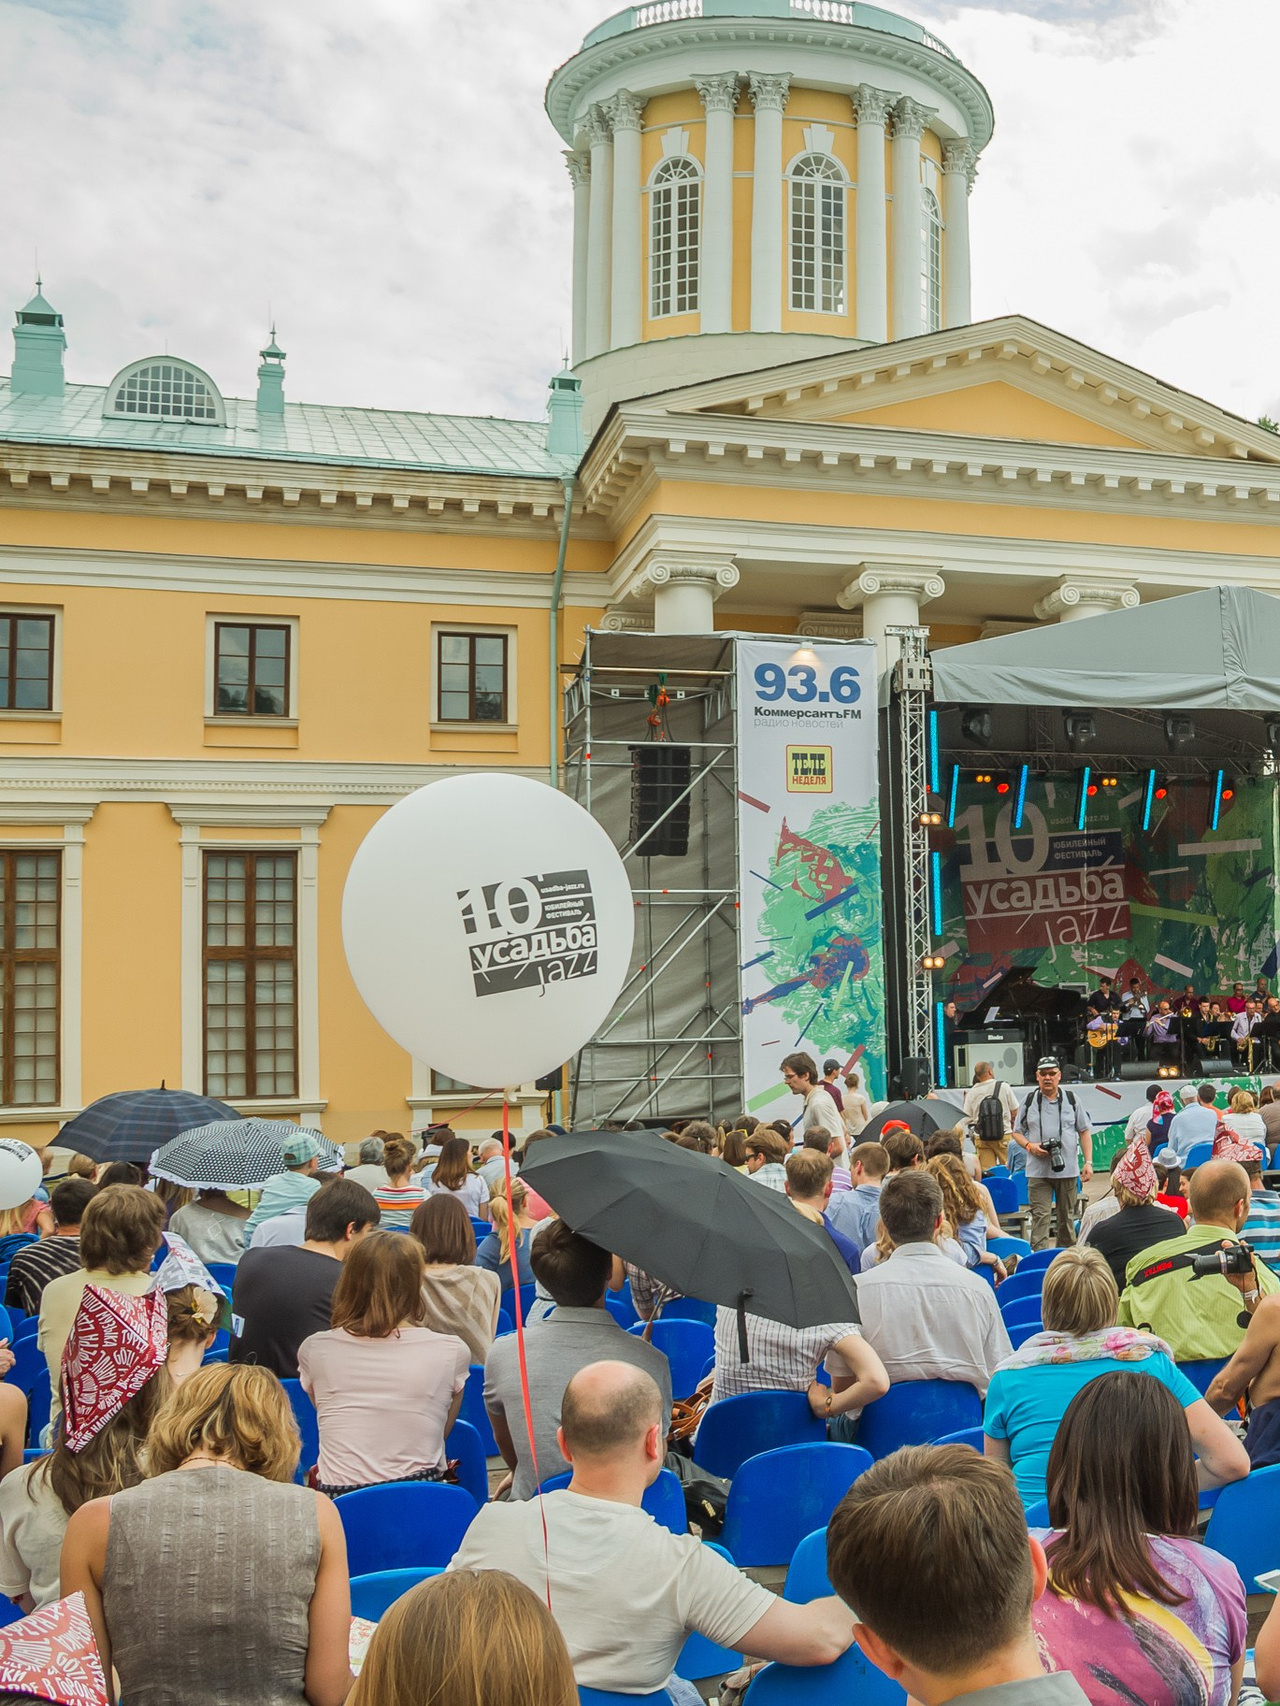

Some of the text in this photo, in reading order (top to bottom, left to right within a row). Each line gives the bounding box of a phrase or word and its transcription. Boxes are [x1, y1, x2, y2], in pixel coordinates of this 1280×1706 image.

[754, 662, 861, 704] 93.6
[754, 718, 844, 729] радио новостей
[792, 753, 826, 775] ТЕЛЕ
[792, 776, 827, 786] НЕДЕЛЯ
[955, 801, 1050, 881] 10
[1053, 837, 1106, 849] ЮБИЛЕЙНЫЙ
[1054, 850, 1103, 860] ФЕСТИВАЛЬ
[540, 883, 585, 895] usadba-jazz.ru
[966, 857, 1126, 916] усадьба
[456, 876, 543, 944] 10
[544, 900, 585, 912] ЮБИЛЕЙНЫЙ
[545, 909, 582, 919] ФЕСТИВАЛЬ
[472, 916, 596, 970] усадьба
[1044, 904, 1128, 964] jazz
[538, 951, 596, 998] jazz
[1143, 1260, 1173, 1278] PENTAX
